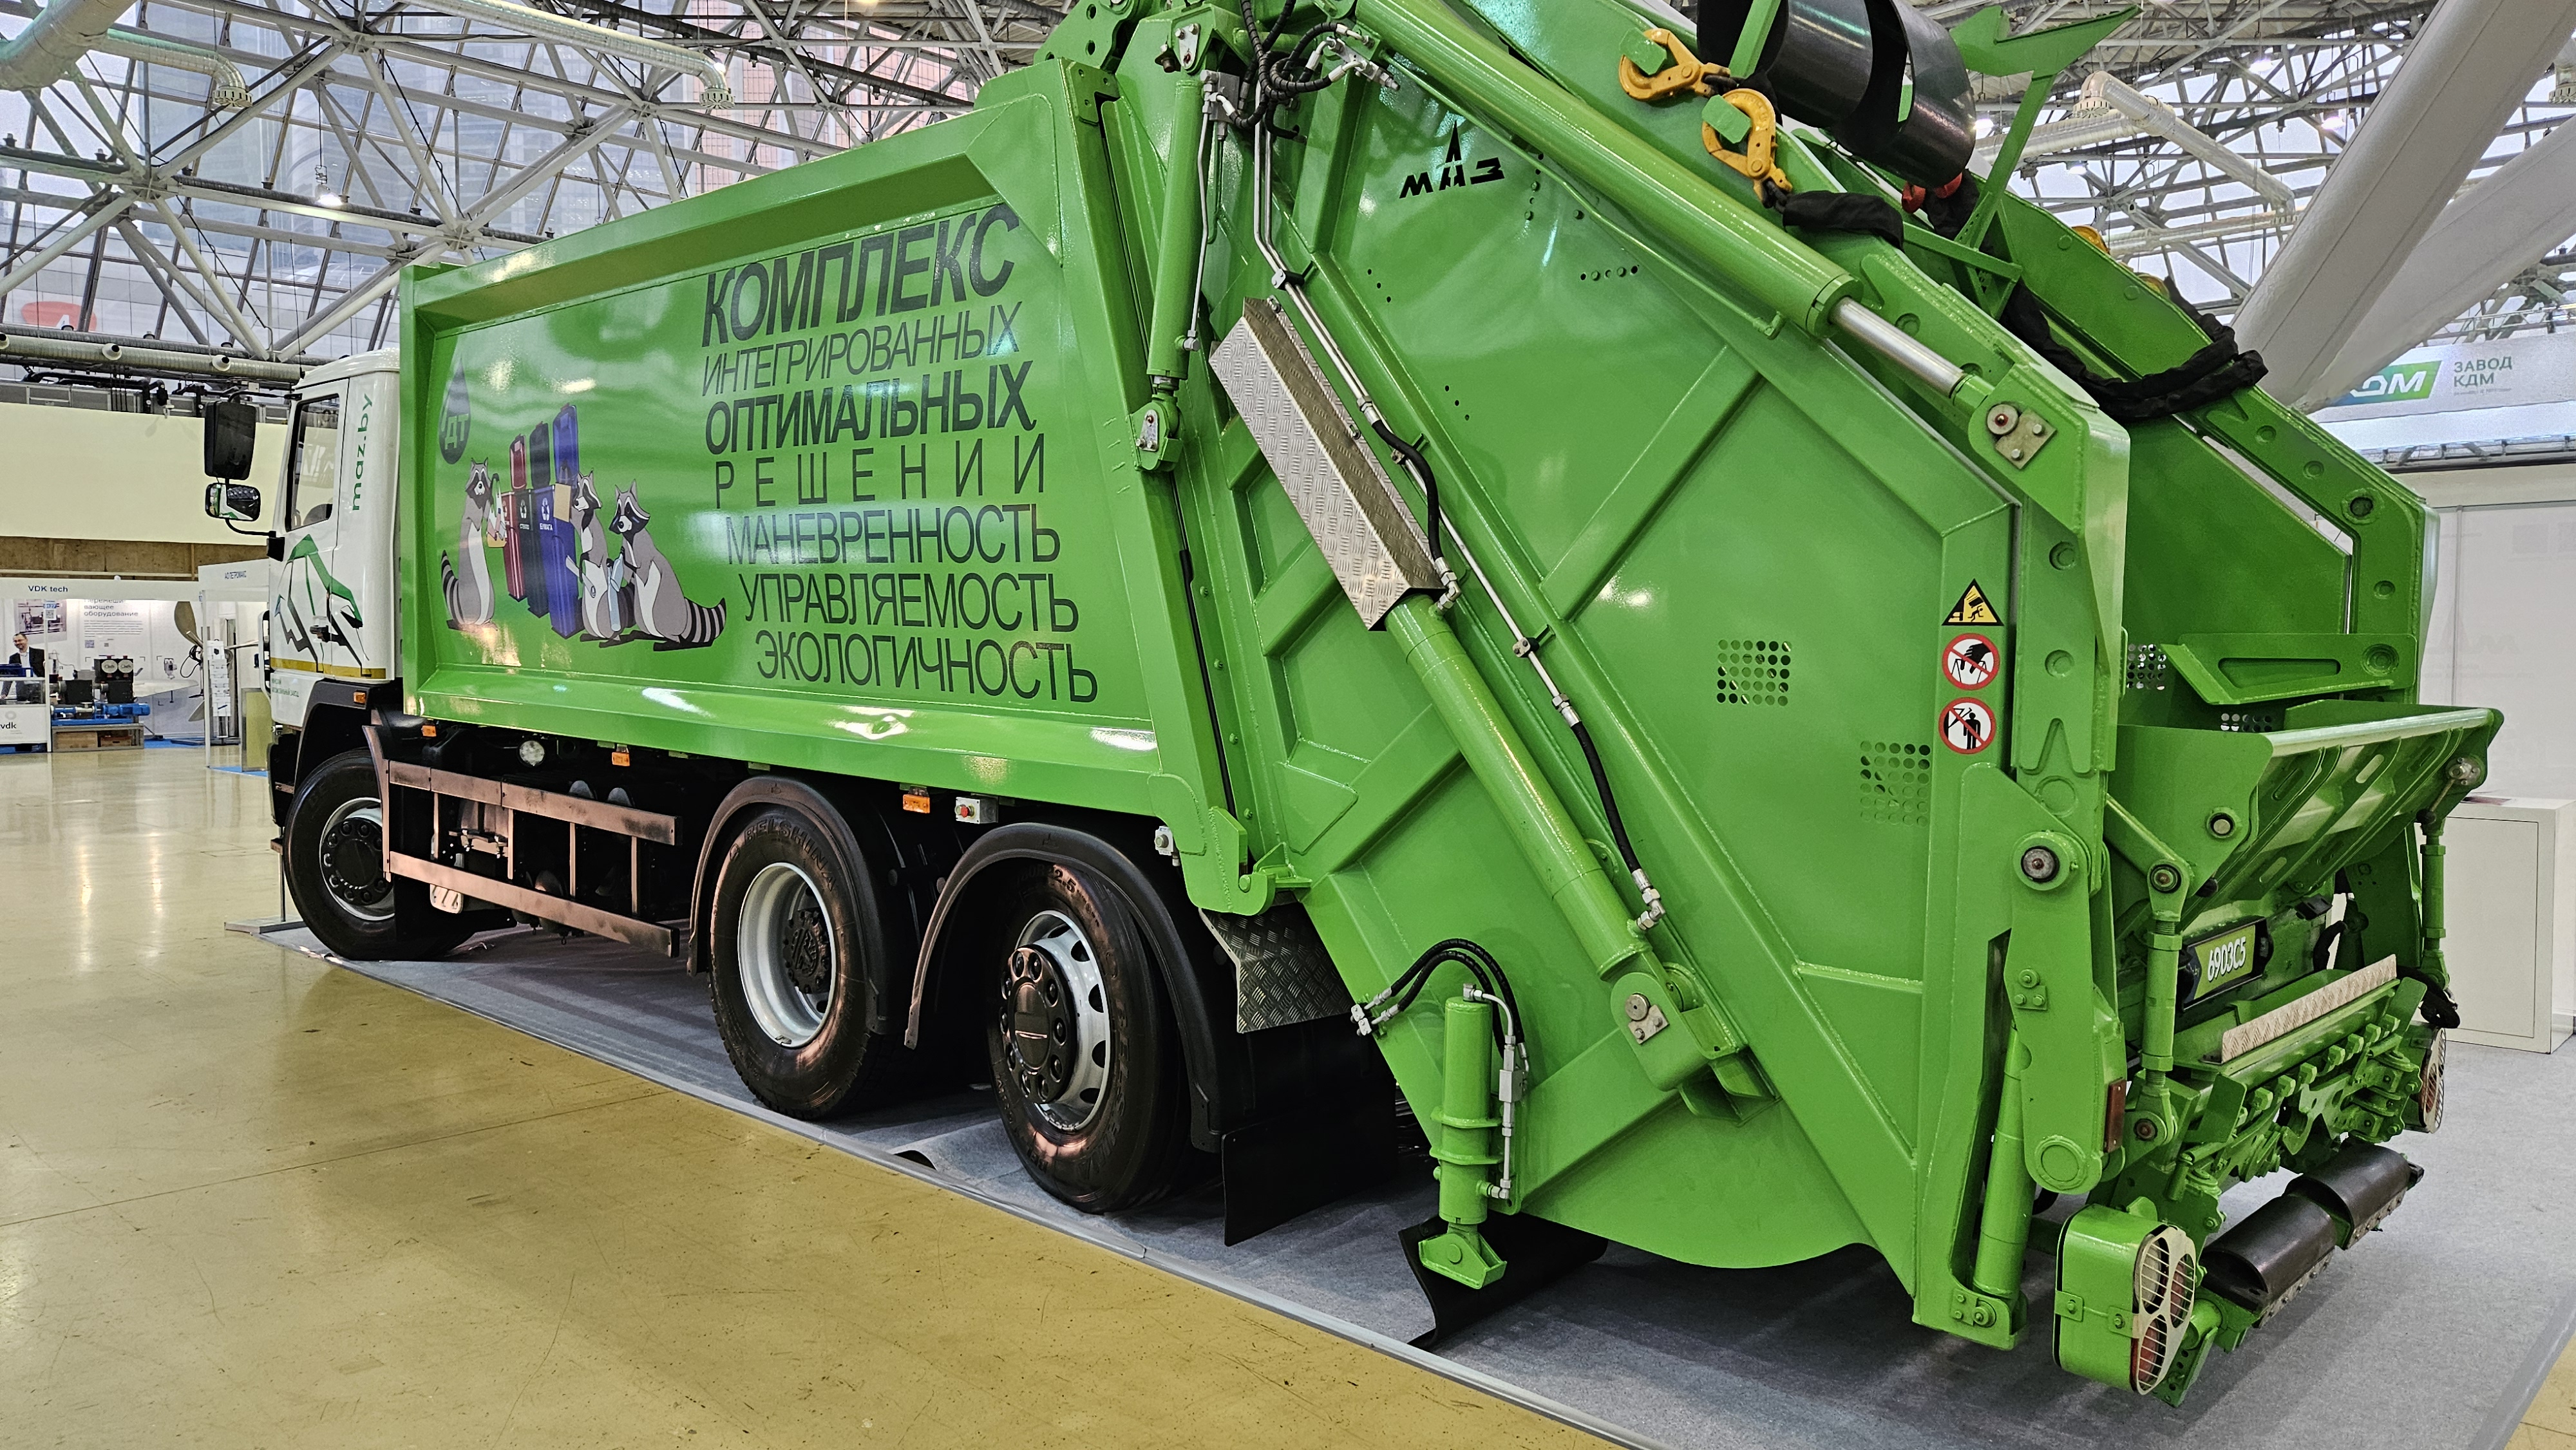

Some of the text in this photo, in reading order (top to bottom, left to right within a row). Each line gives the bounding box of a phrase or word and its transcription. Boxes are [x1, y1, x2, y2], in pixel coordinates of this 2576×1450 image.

[1399, 120, 1505, 199] МАЗ
[702, 203, 1019, 347] КОМПЛЕКС
[702, 301, 1022, 397] ИНТЕГРИРОВАННЫХ
[2454, 356, 2512, 373] ЗАВОД
[2454, 372, 2494, 387] КДМ
[705, 361, 1037, 455] ОПТИМАЛЬНЫХ
[352, 393, 373, 511] maz.by
[726, 504, 1061, 565] МАНЕВРЕННОСТЬ
[739, 573, 1079, 632] УПРАВЛЯЕМОСТЬ
[755, 629, 1099, 702] ЭКОЛОГИЧНОСТЬ
[0, 721, 17, 730] vdk
[744, 818, 837, 892] BELSHINA
